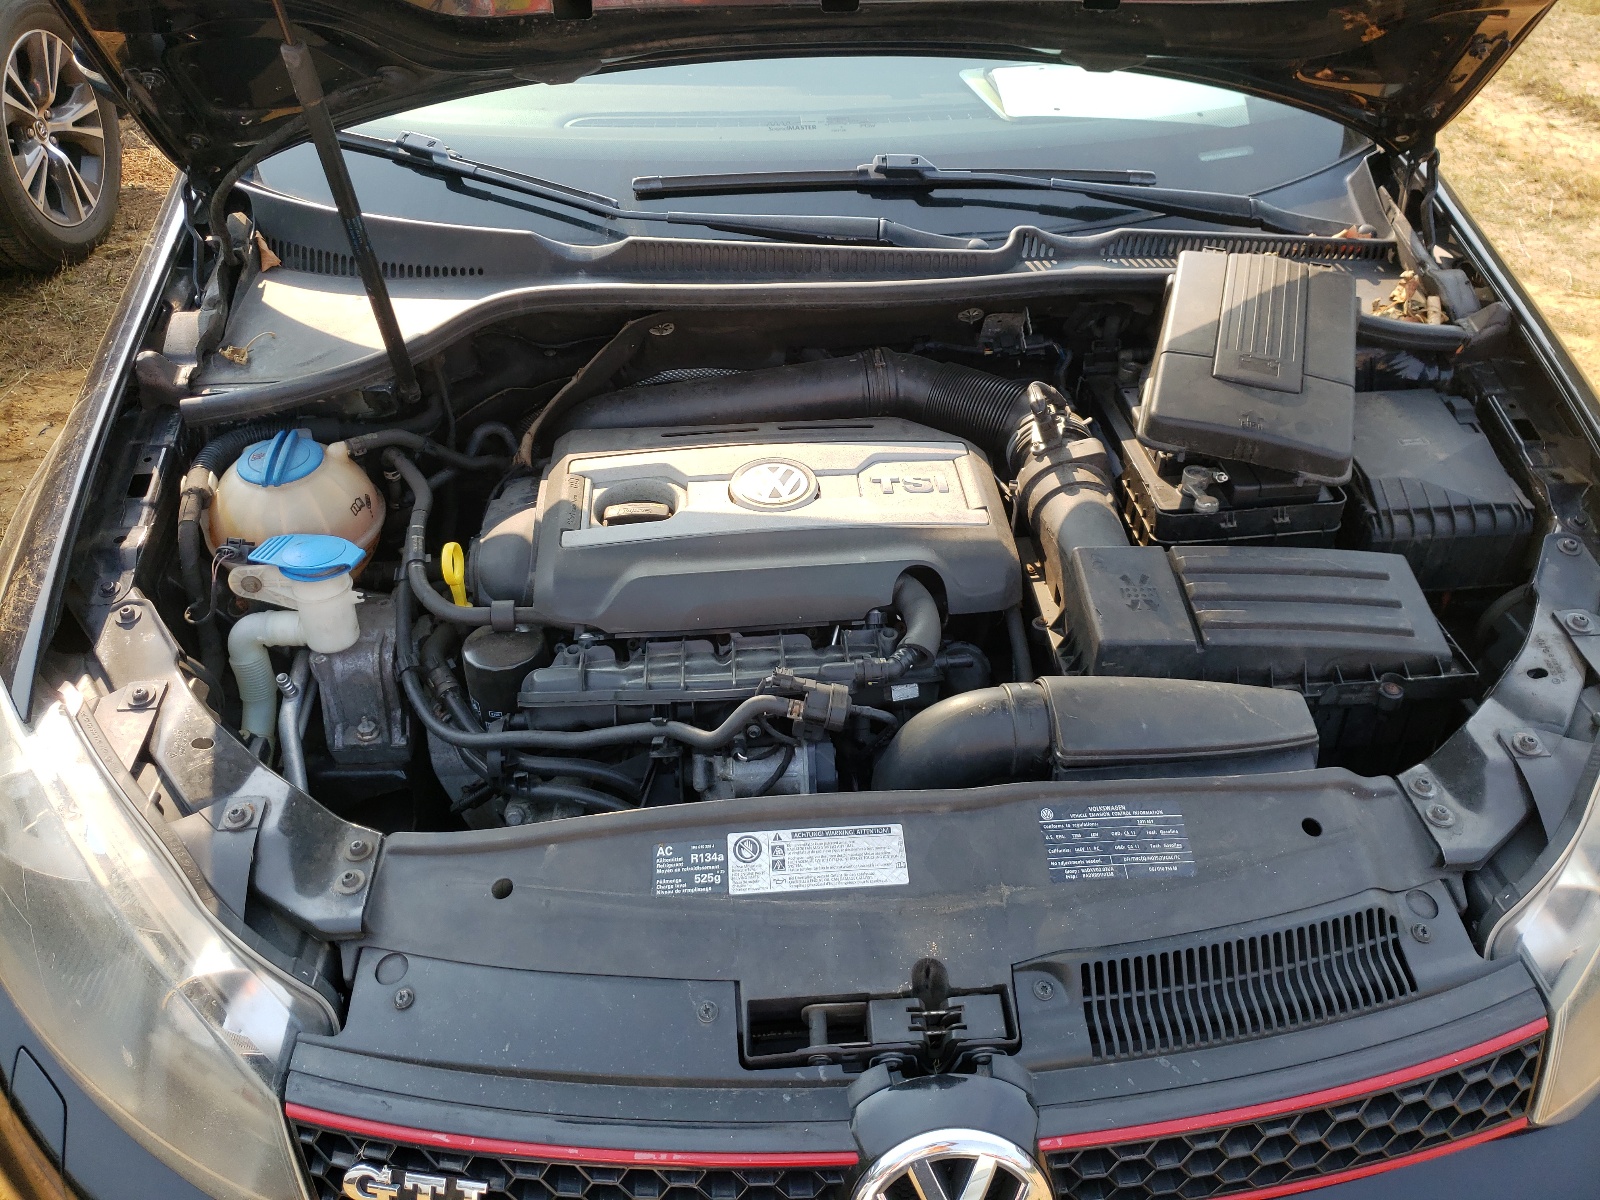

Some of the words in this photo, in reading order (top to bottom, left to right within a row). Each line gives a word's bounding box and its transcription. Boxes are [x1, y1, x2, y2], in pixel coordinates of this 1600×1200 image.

[871, 476, 949, 494] TSI
[656, 846, 673, 857] AC
[690, 852, 725, 864] R134a
[694, 872, 721, 884] 525g
